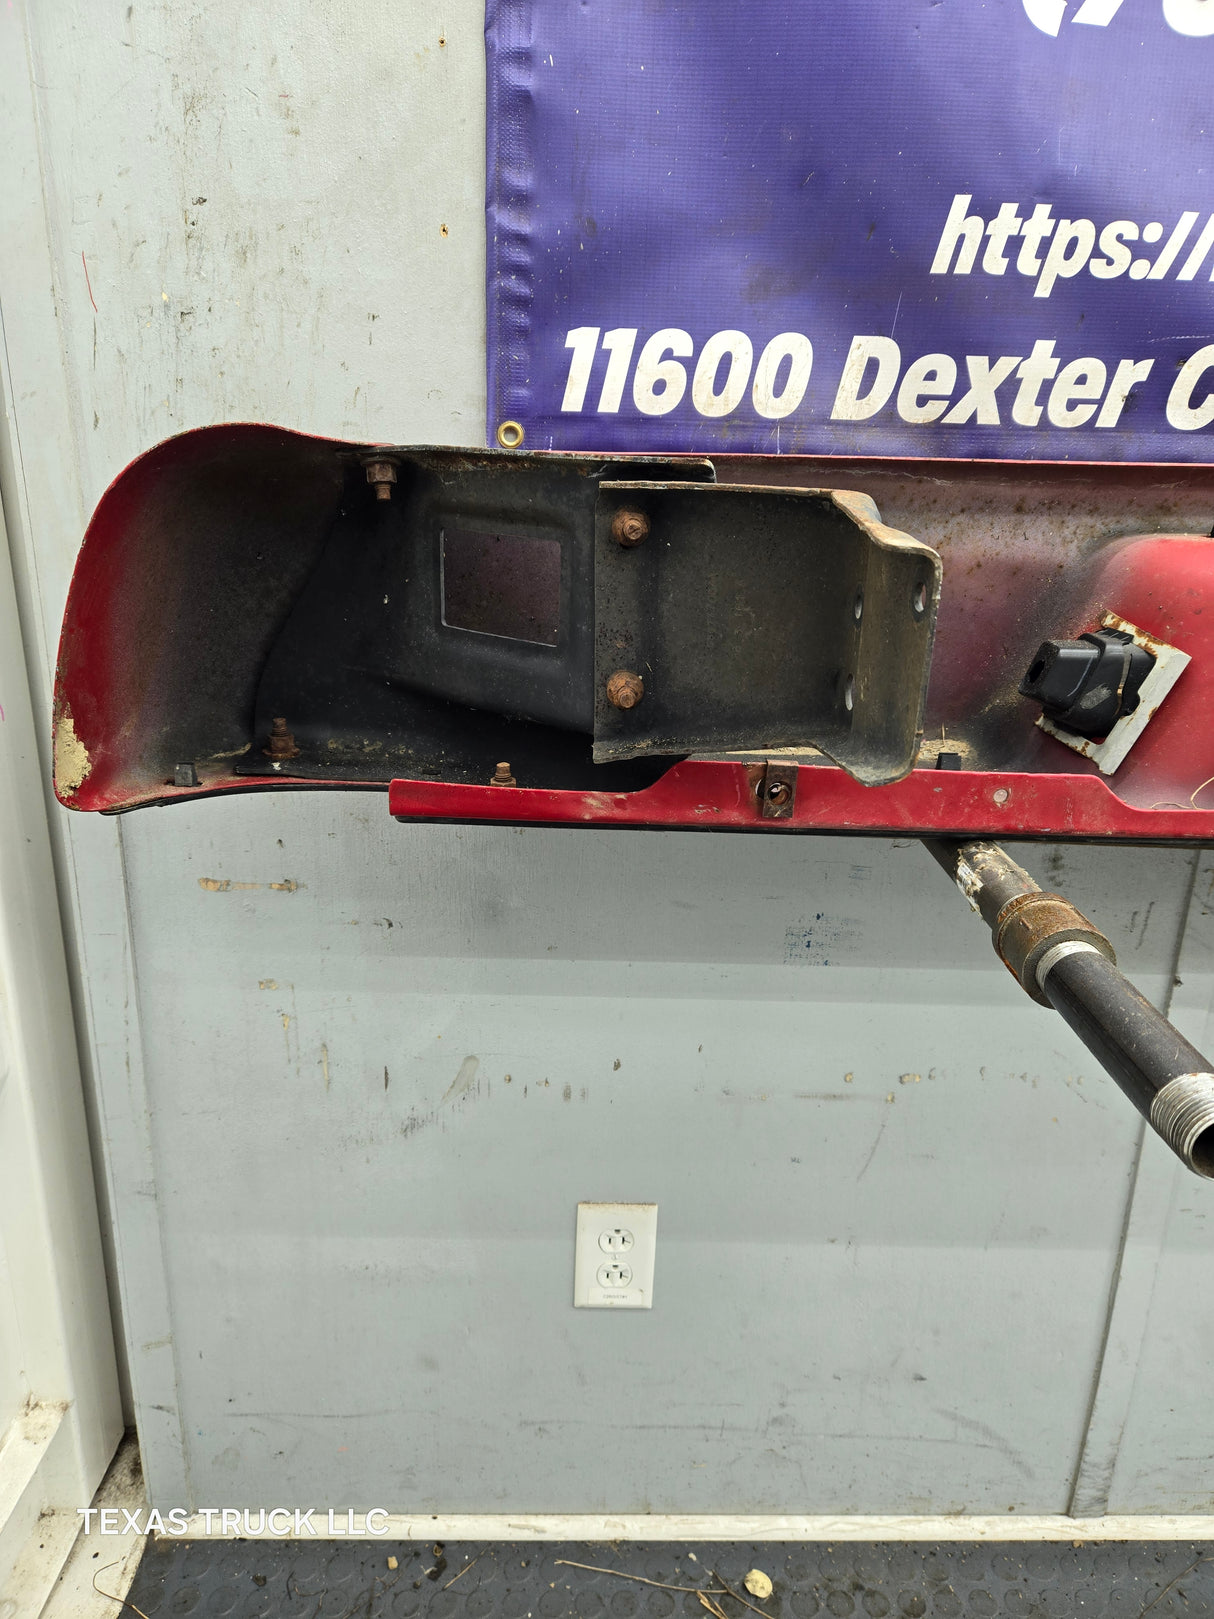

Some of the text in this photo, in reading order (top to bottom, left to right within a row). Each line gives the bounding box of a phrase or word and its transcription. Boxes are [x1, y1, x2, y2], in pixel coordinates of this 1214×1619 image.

[930, 194, 1214, 298] https://
[561, 326, 814, 420] 11600
[830, 335, 1155, 429] Dexter
